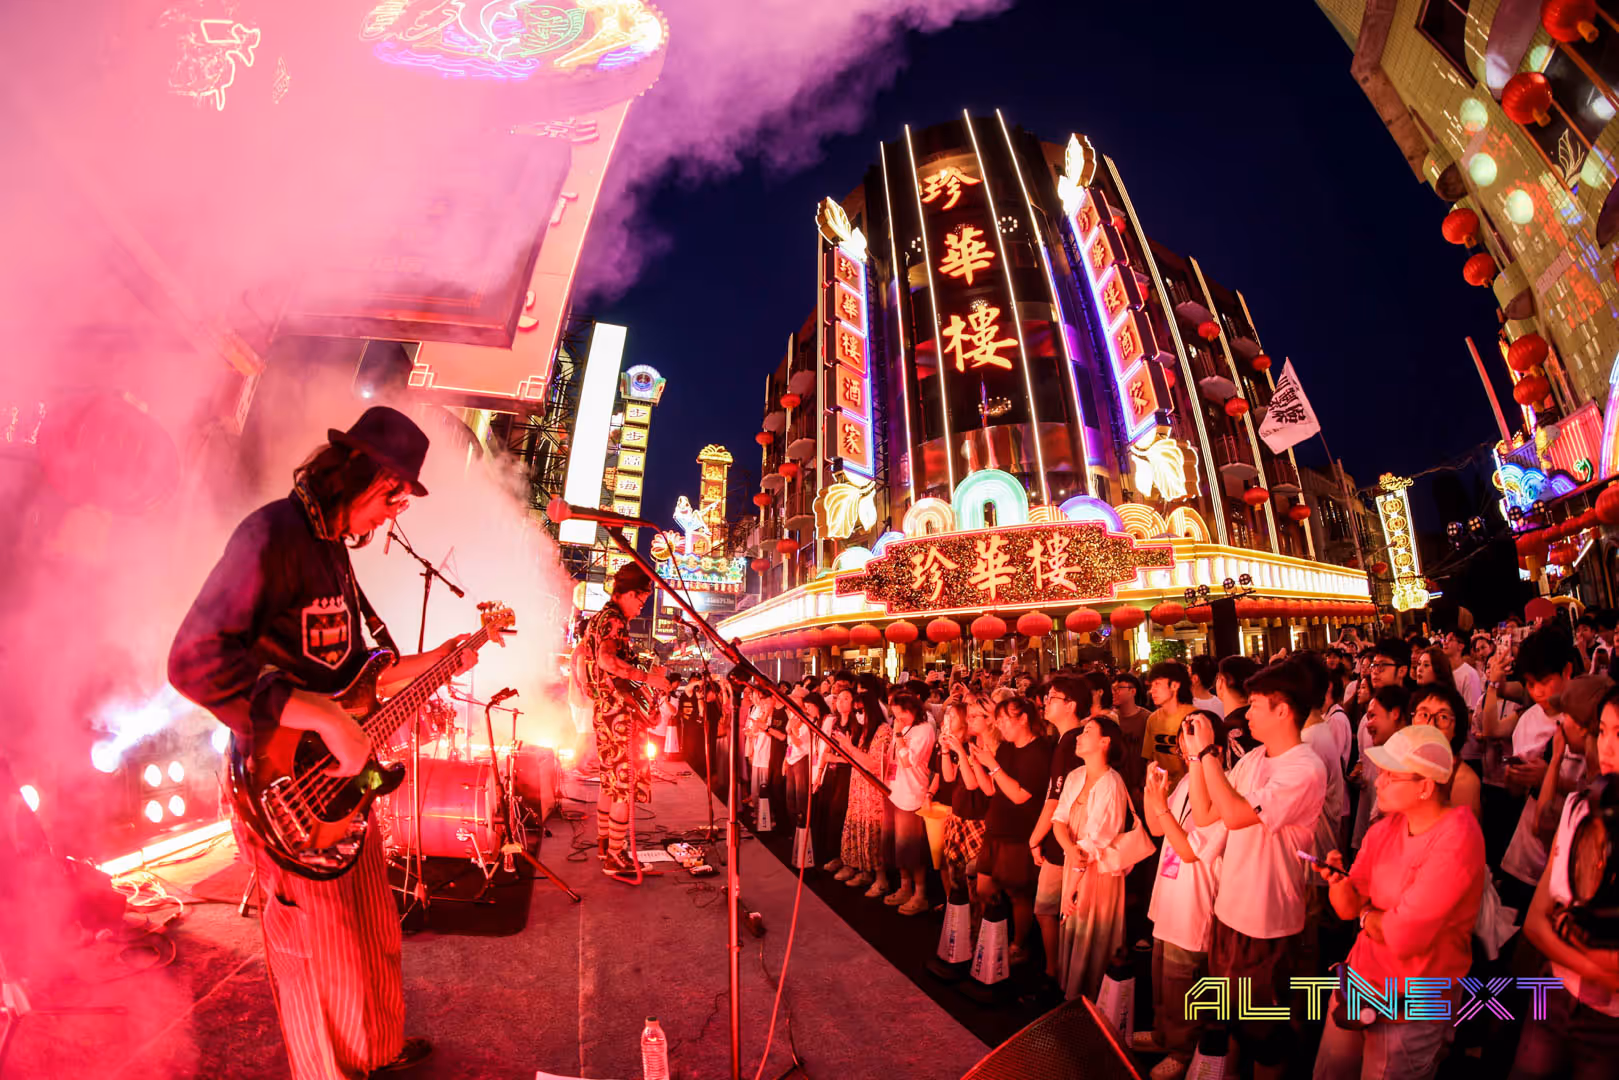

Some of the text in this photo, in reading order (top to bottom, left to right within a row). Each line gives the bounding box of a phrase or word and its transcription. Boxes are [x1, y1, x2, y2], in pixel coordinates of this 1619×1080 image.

[838, 257, 862, 455] 珍華樓酒家
[921, 166, 1019, 373] 珍華樓
[910, 532, 1083, 602] 珍華樓
